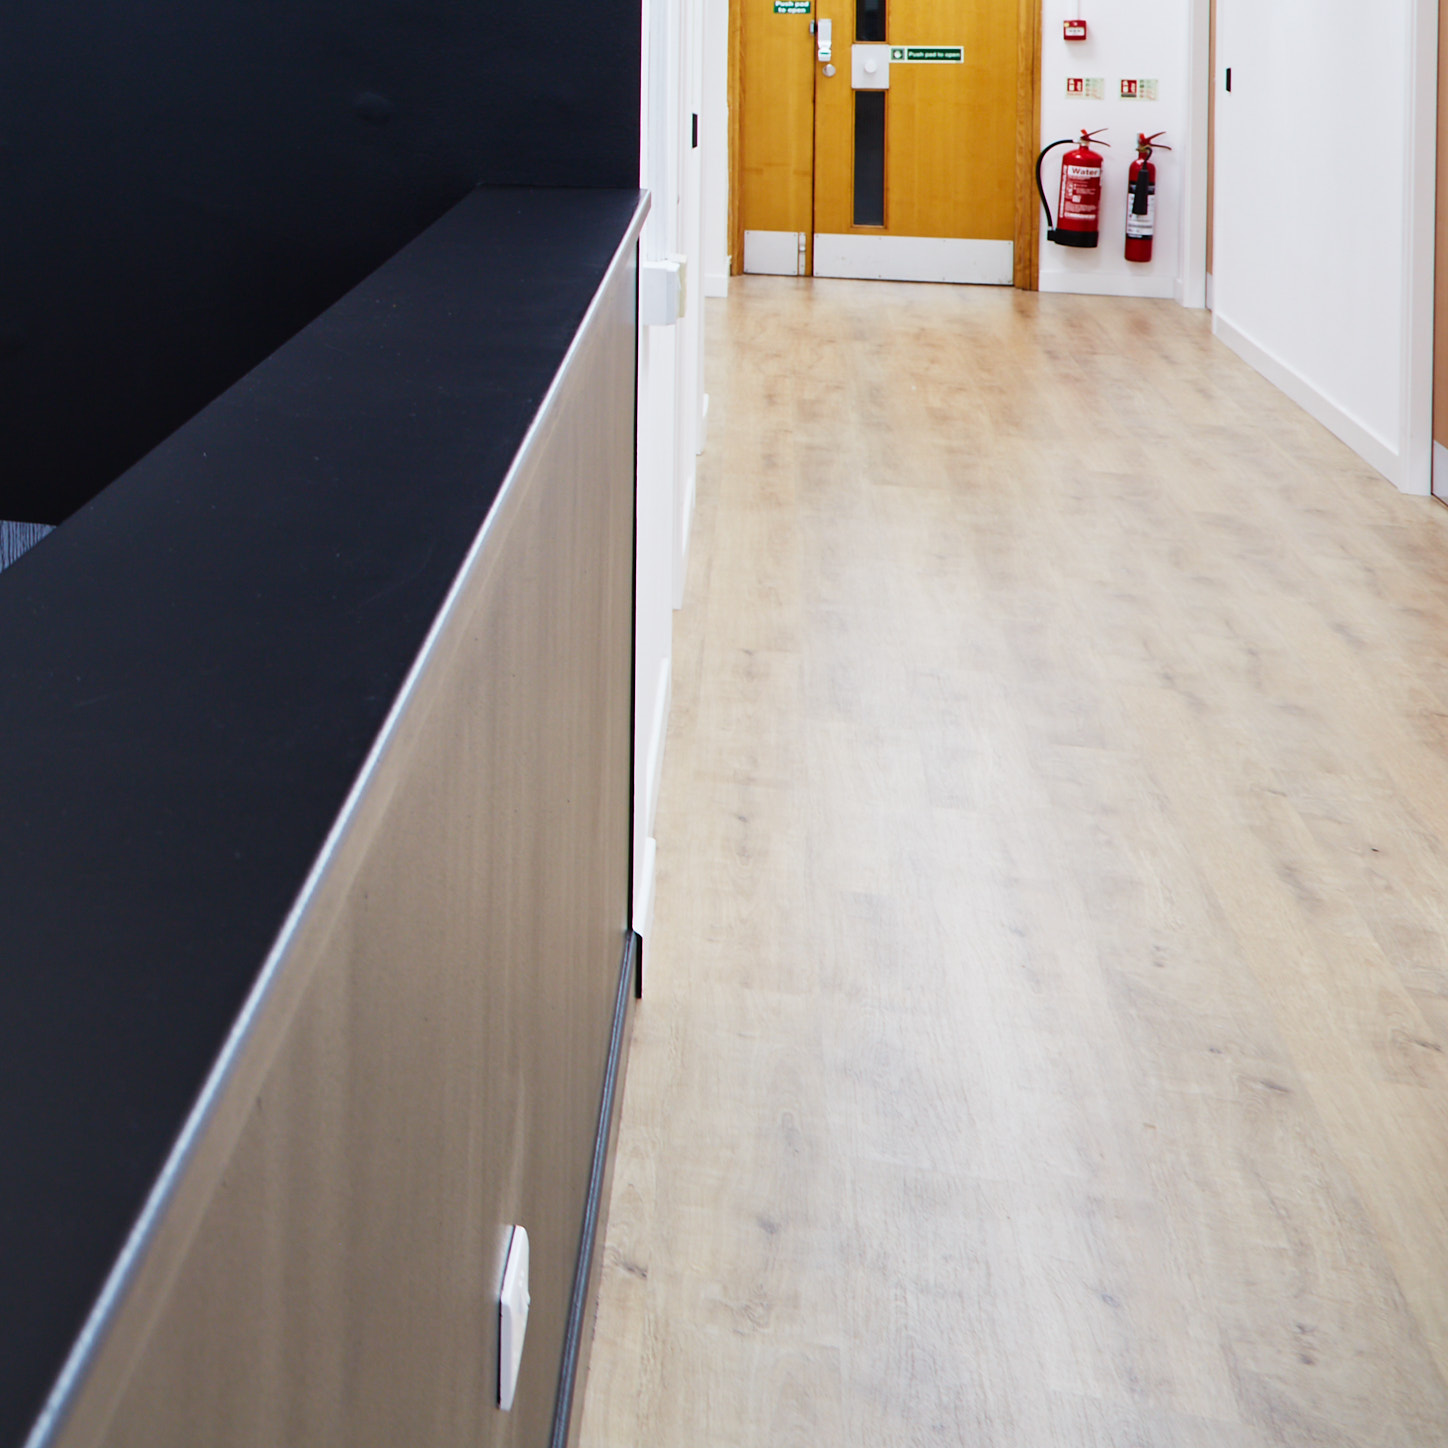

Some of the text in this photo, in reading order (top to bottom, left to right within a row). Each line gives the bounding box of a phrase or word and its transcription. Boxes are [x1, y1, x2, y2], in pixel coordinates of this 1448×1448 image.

[794, 0, 810, 8] pad
[924, 51, 937, 59] pad
[1072, 167, 1098, 176] Water
